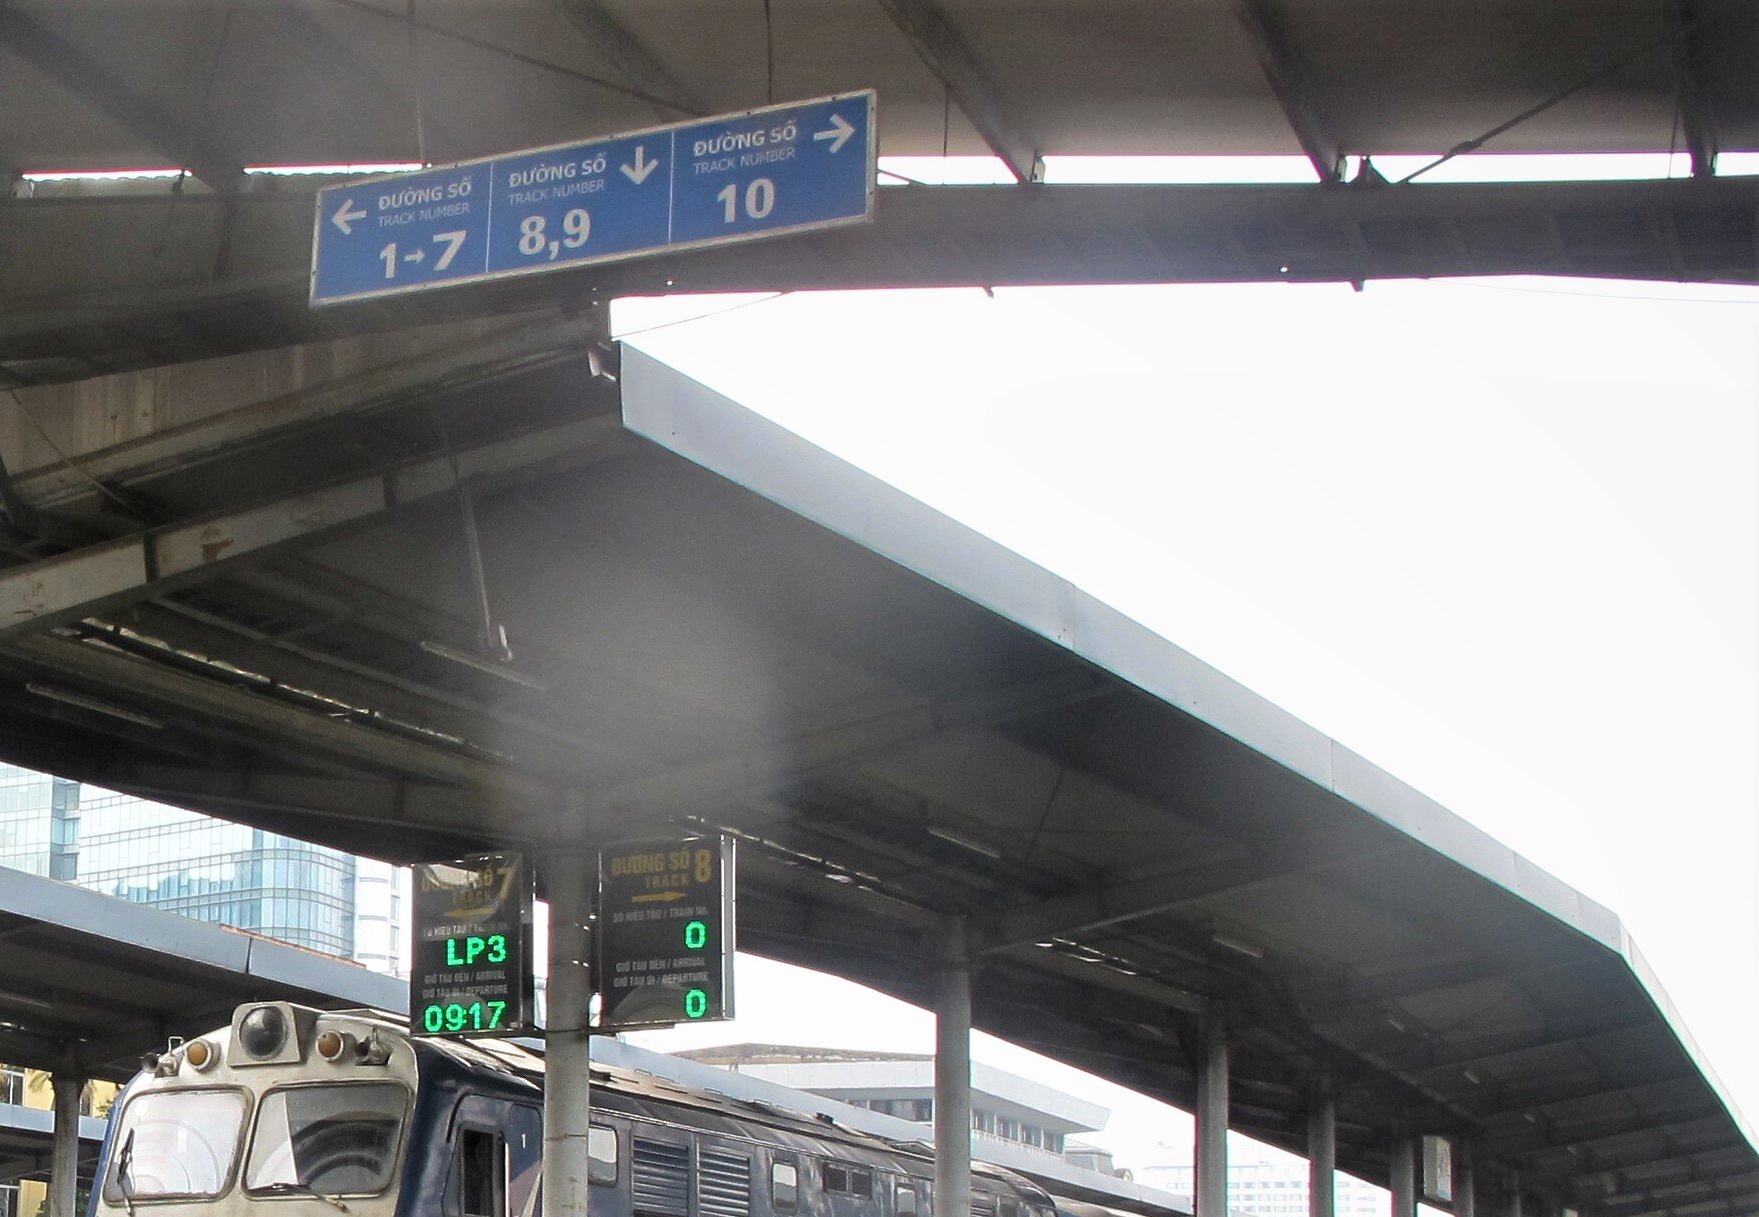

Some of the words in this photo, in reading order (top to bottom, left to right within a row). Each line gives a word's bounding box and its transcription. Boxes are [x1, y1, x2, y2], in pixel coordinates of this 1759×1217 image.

[693, 130, 766, 157] ĐƯỜNG
[770, 119, 798, 143] SỐ
[508, 162, 577, 188] ĐƯỜNG
[581, 152, 608, 176] SỐ
[694, 157, 735, 175] TRACK
[740, 147, 796, 167] NUMBER
[378, 185, 443, 210] ĐƯỜNG
[447, 176, 472, 198] SỐ
[508, 189, 548, 205] TRACK
[553, 179, 605, 198] NUMBER
[717, 178, 775, 223] 10
[378, 211, 415, 227] TRACK
[419, 202, 470, 220] NUMBER
[518, 208, 591, 261] 8,9
[693, 850, 711, 883] 8
[446, 934, 507, 967] LP3
[685, 921, 708, 949] 0
[685, 989, 708, 1019] 0
